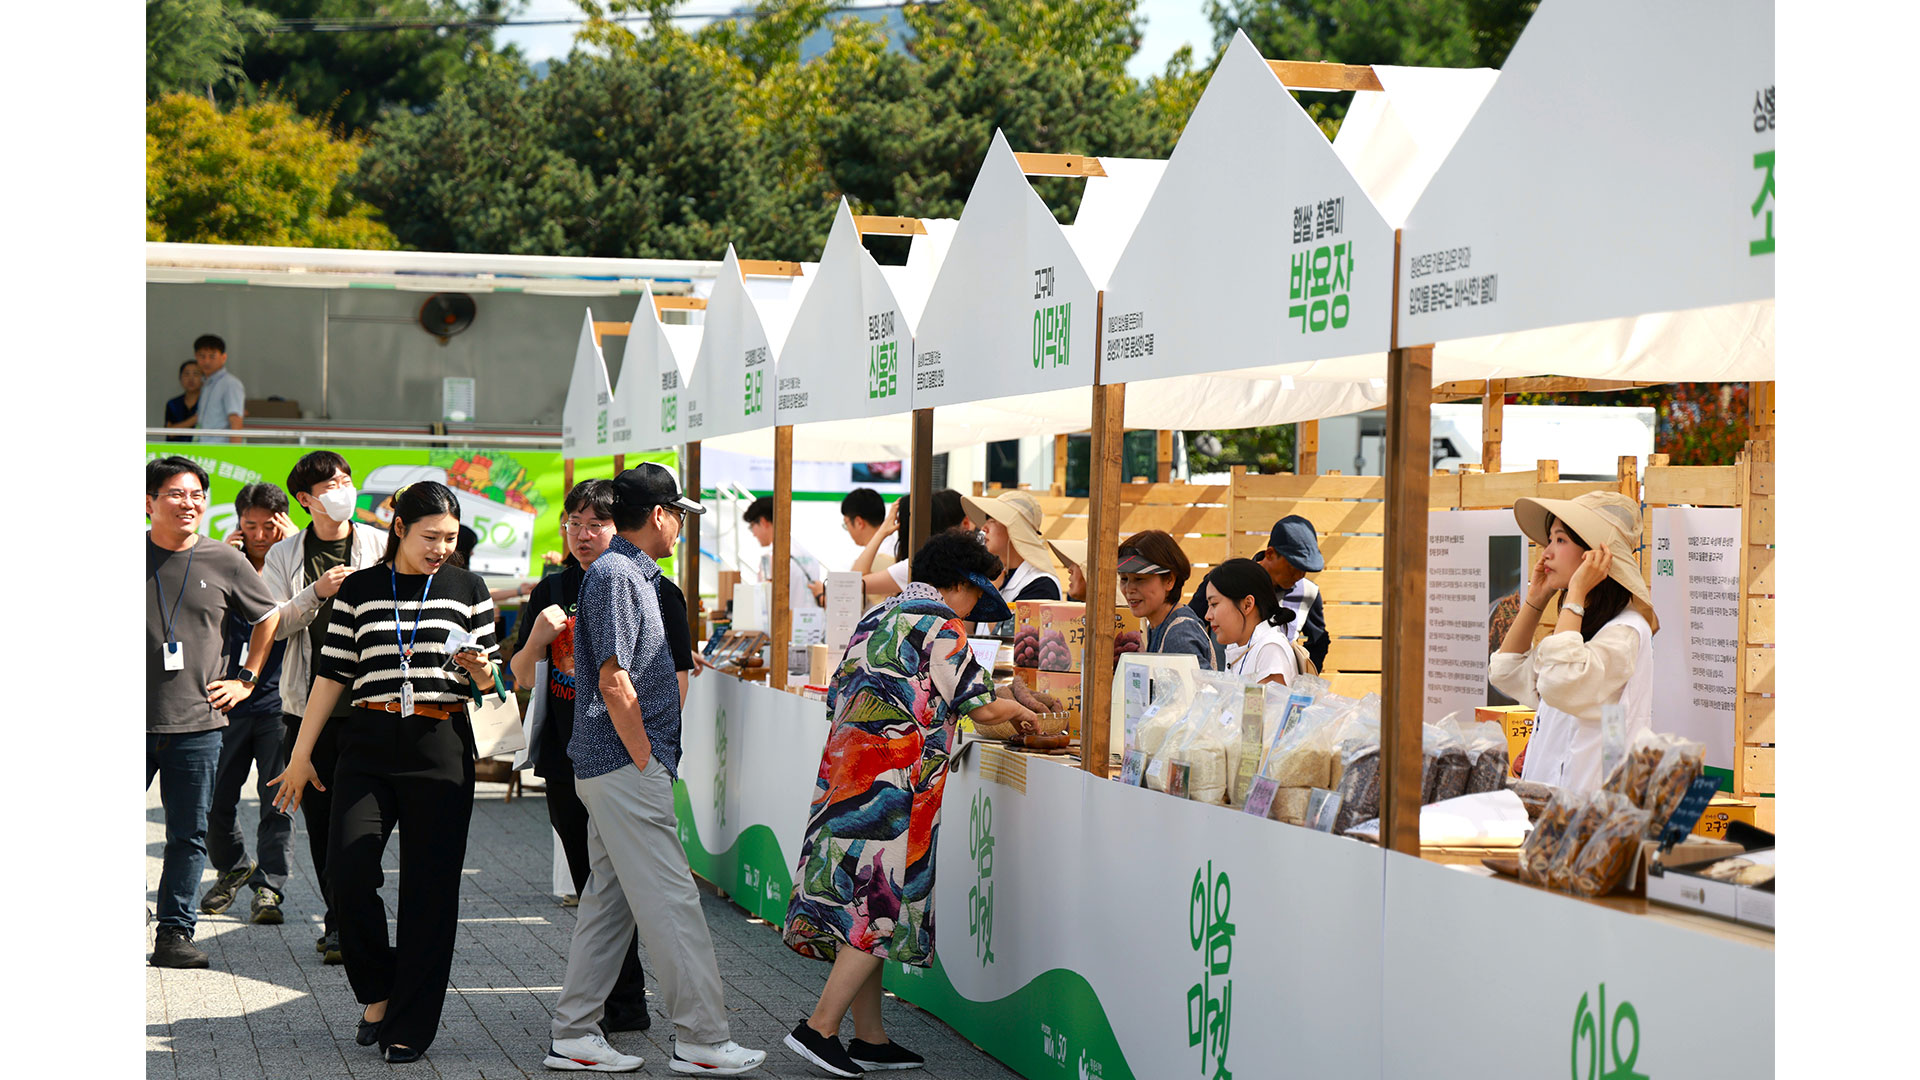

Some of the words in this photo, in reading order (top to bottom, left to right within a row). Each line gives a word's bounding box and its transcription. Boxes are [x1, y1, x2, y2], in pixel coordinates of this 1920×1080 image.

[1293, 205, 1315, 244] 햅쌀,
[1315, 196, 1345, 239] 찰흑미
[1033, 265, 1056, 300] 고구마
[1288, 240, 1355, 335] 박용장
[1409, 284, 1431, 316] 입맛을
[1454, 276, 1480, 308] 바삭한
[1481, 273, 1499, 305] 별미
[1032, 301, 1072, 371] 이막례
[473, 515, 517, 549] 50
[1657, 538, 1671, 551] 고구마
[1069, 627, 1086, 646] 고구
[1067, 695, 1081, 712] 고구
[969, 787, 996, 879] 이음
[968, 875, 995, 969] 마켓
[1189, 859, 1236, 976] 이음
[1187, 971, 1233, 1080] 마켓
